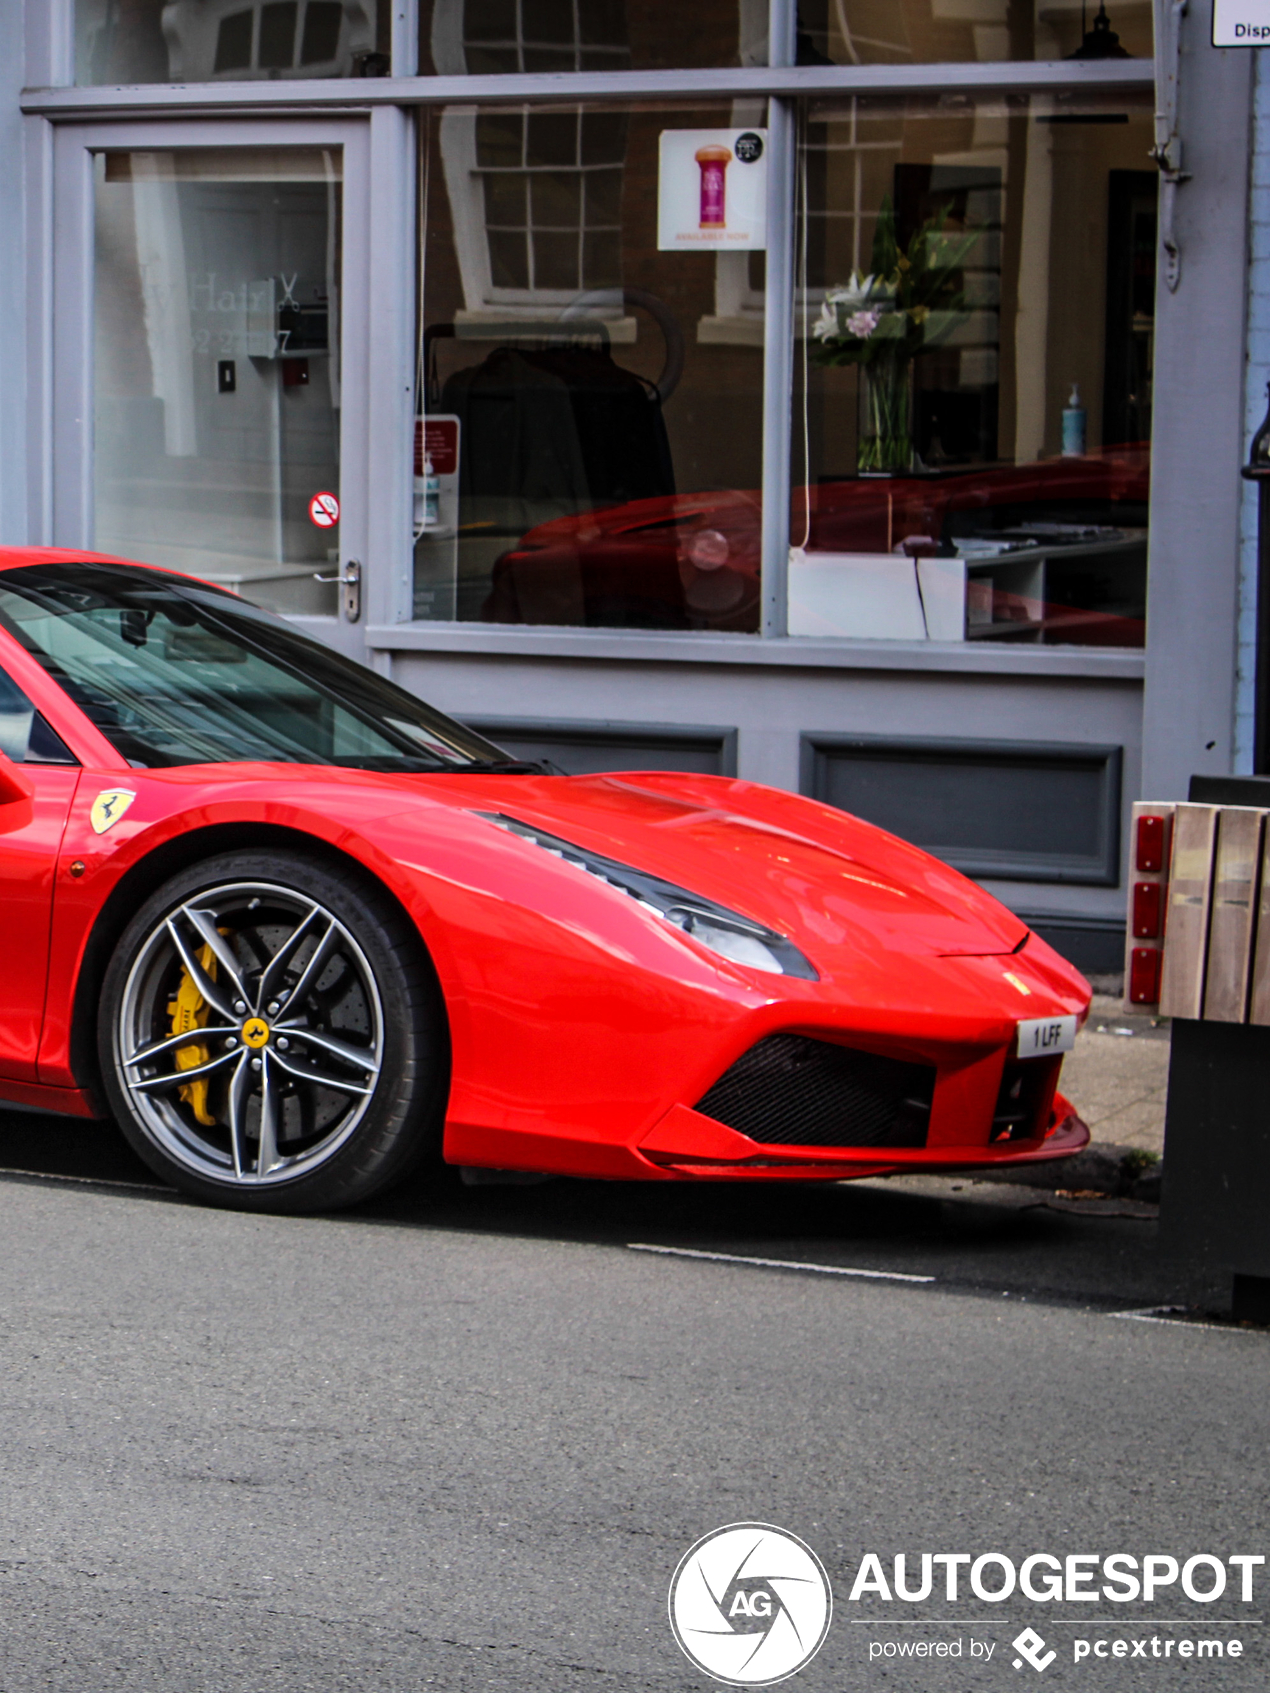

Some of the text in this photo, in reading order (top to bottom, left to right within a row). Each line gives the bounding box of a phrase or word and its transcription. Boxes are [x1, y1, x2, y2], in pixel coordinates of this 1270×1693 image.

[190, 271, 264, 312] Hair
[1034, 1024, 1061, 1047] 1 LFF
